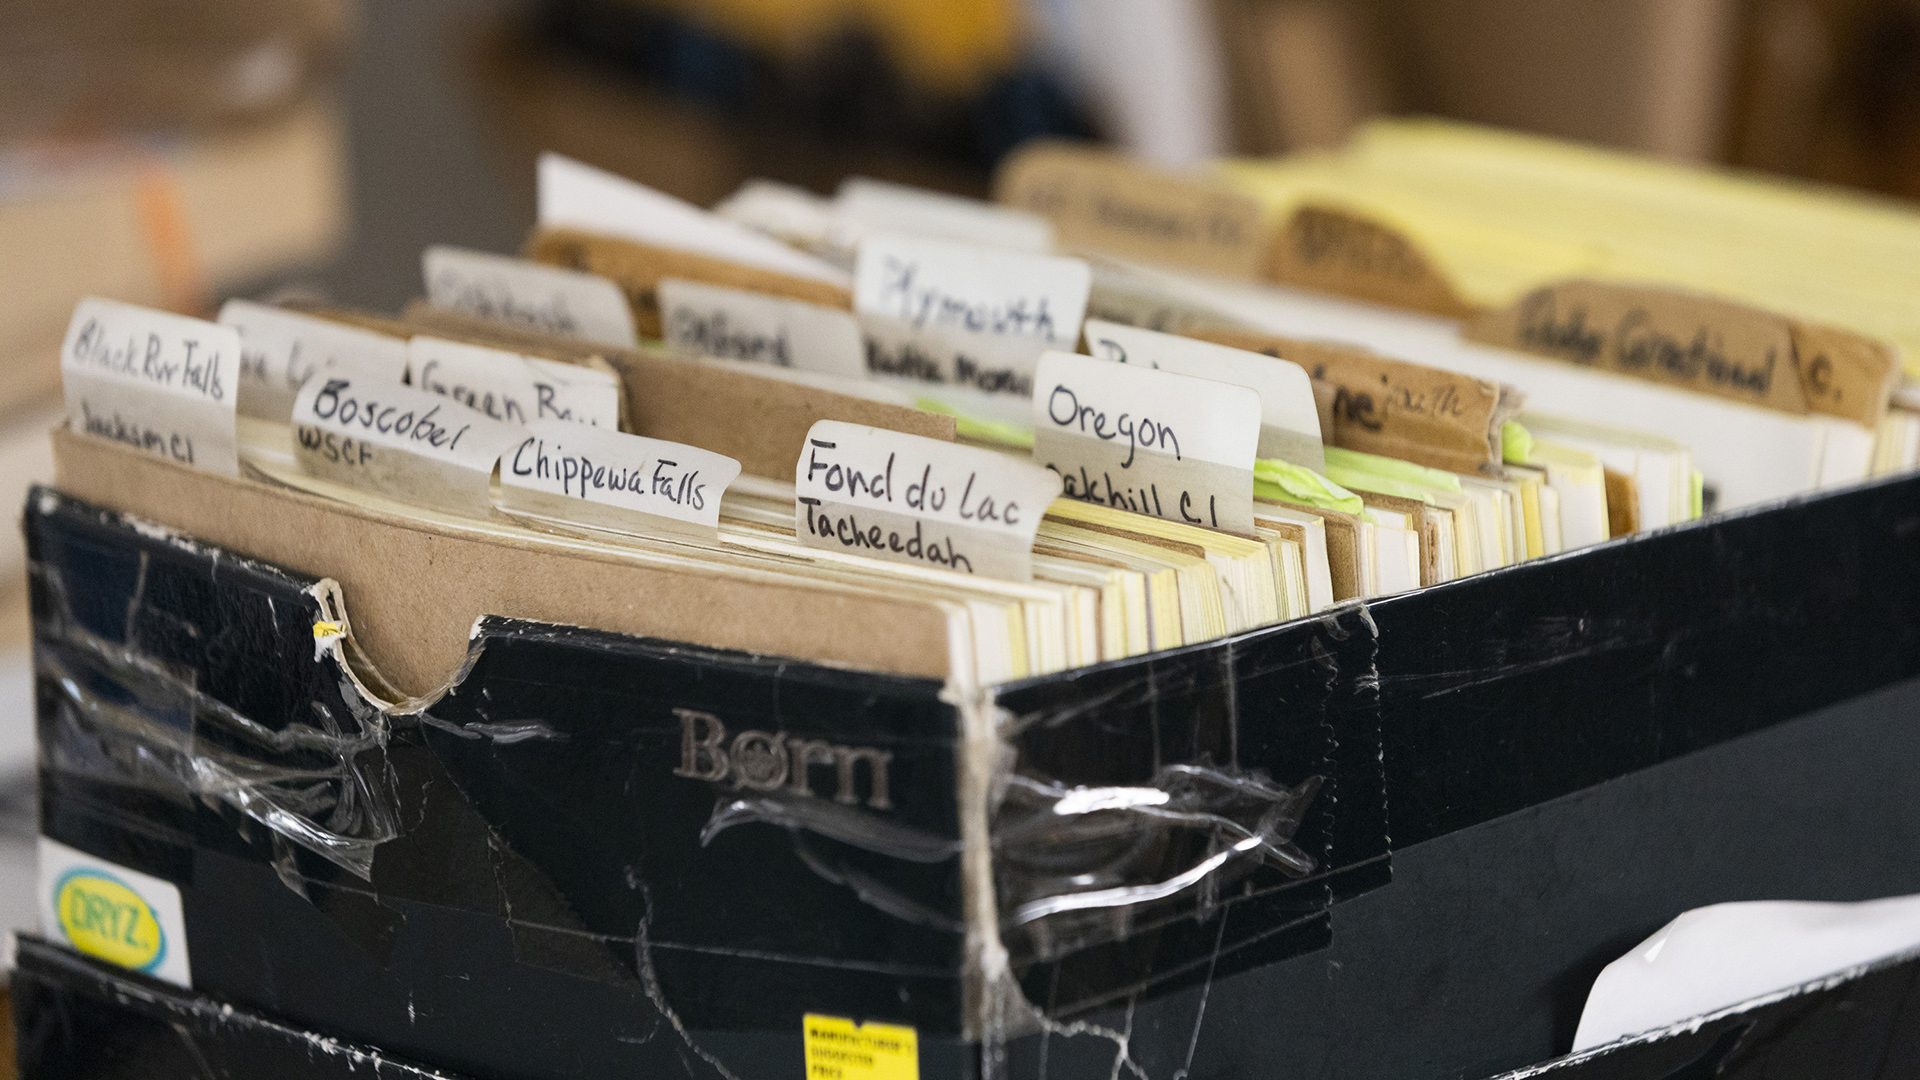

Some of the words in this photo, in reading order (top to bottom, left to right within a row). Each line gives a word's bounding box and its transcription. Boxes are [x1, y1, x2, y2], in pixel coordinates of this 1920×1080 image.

[299, 425, 374, 466] WSCF
[313, 378, 471, 451] Boscobel
[1048, 384, 1182, 469] Oregon
[512, 437, 645, 499] Chippewa
[652, 458, 707, 511] Falls
[807, 438, 895, 502] Fond
[905, 464, 946, 512] du
[959, 472, 1020, 526] Lac
[798, 496, 973, 574] Tacheedah
